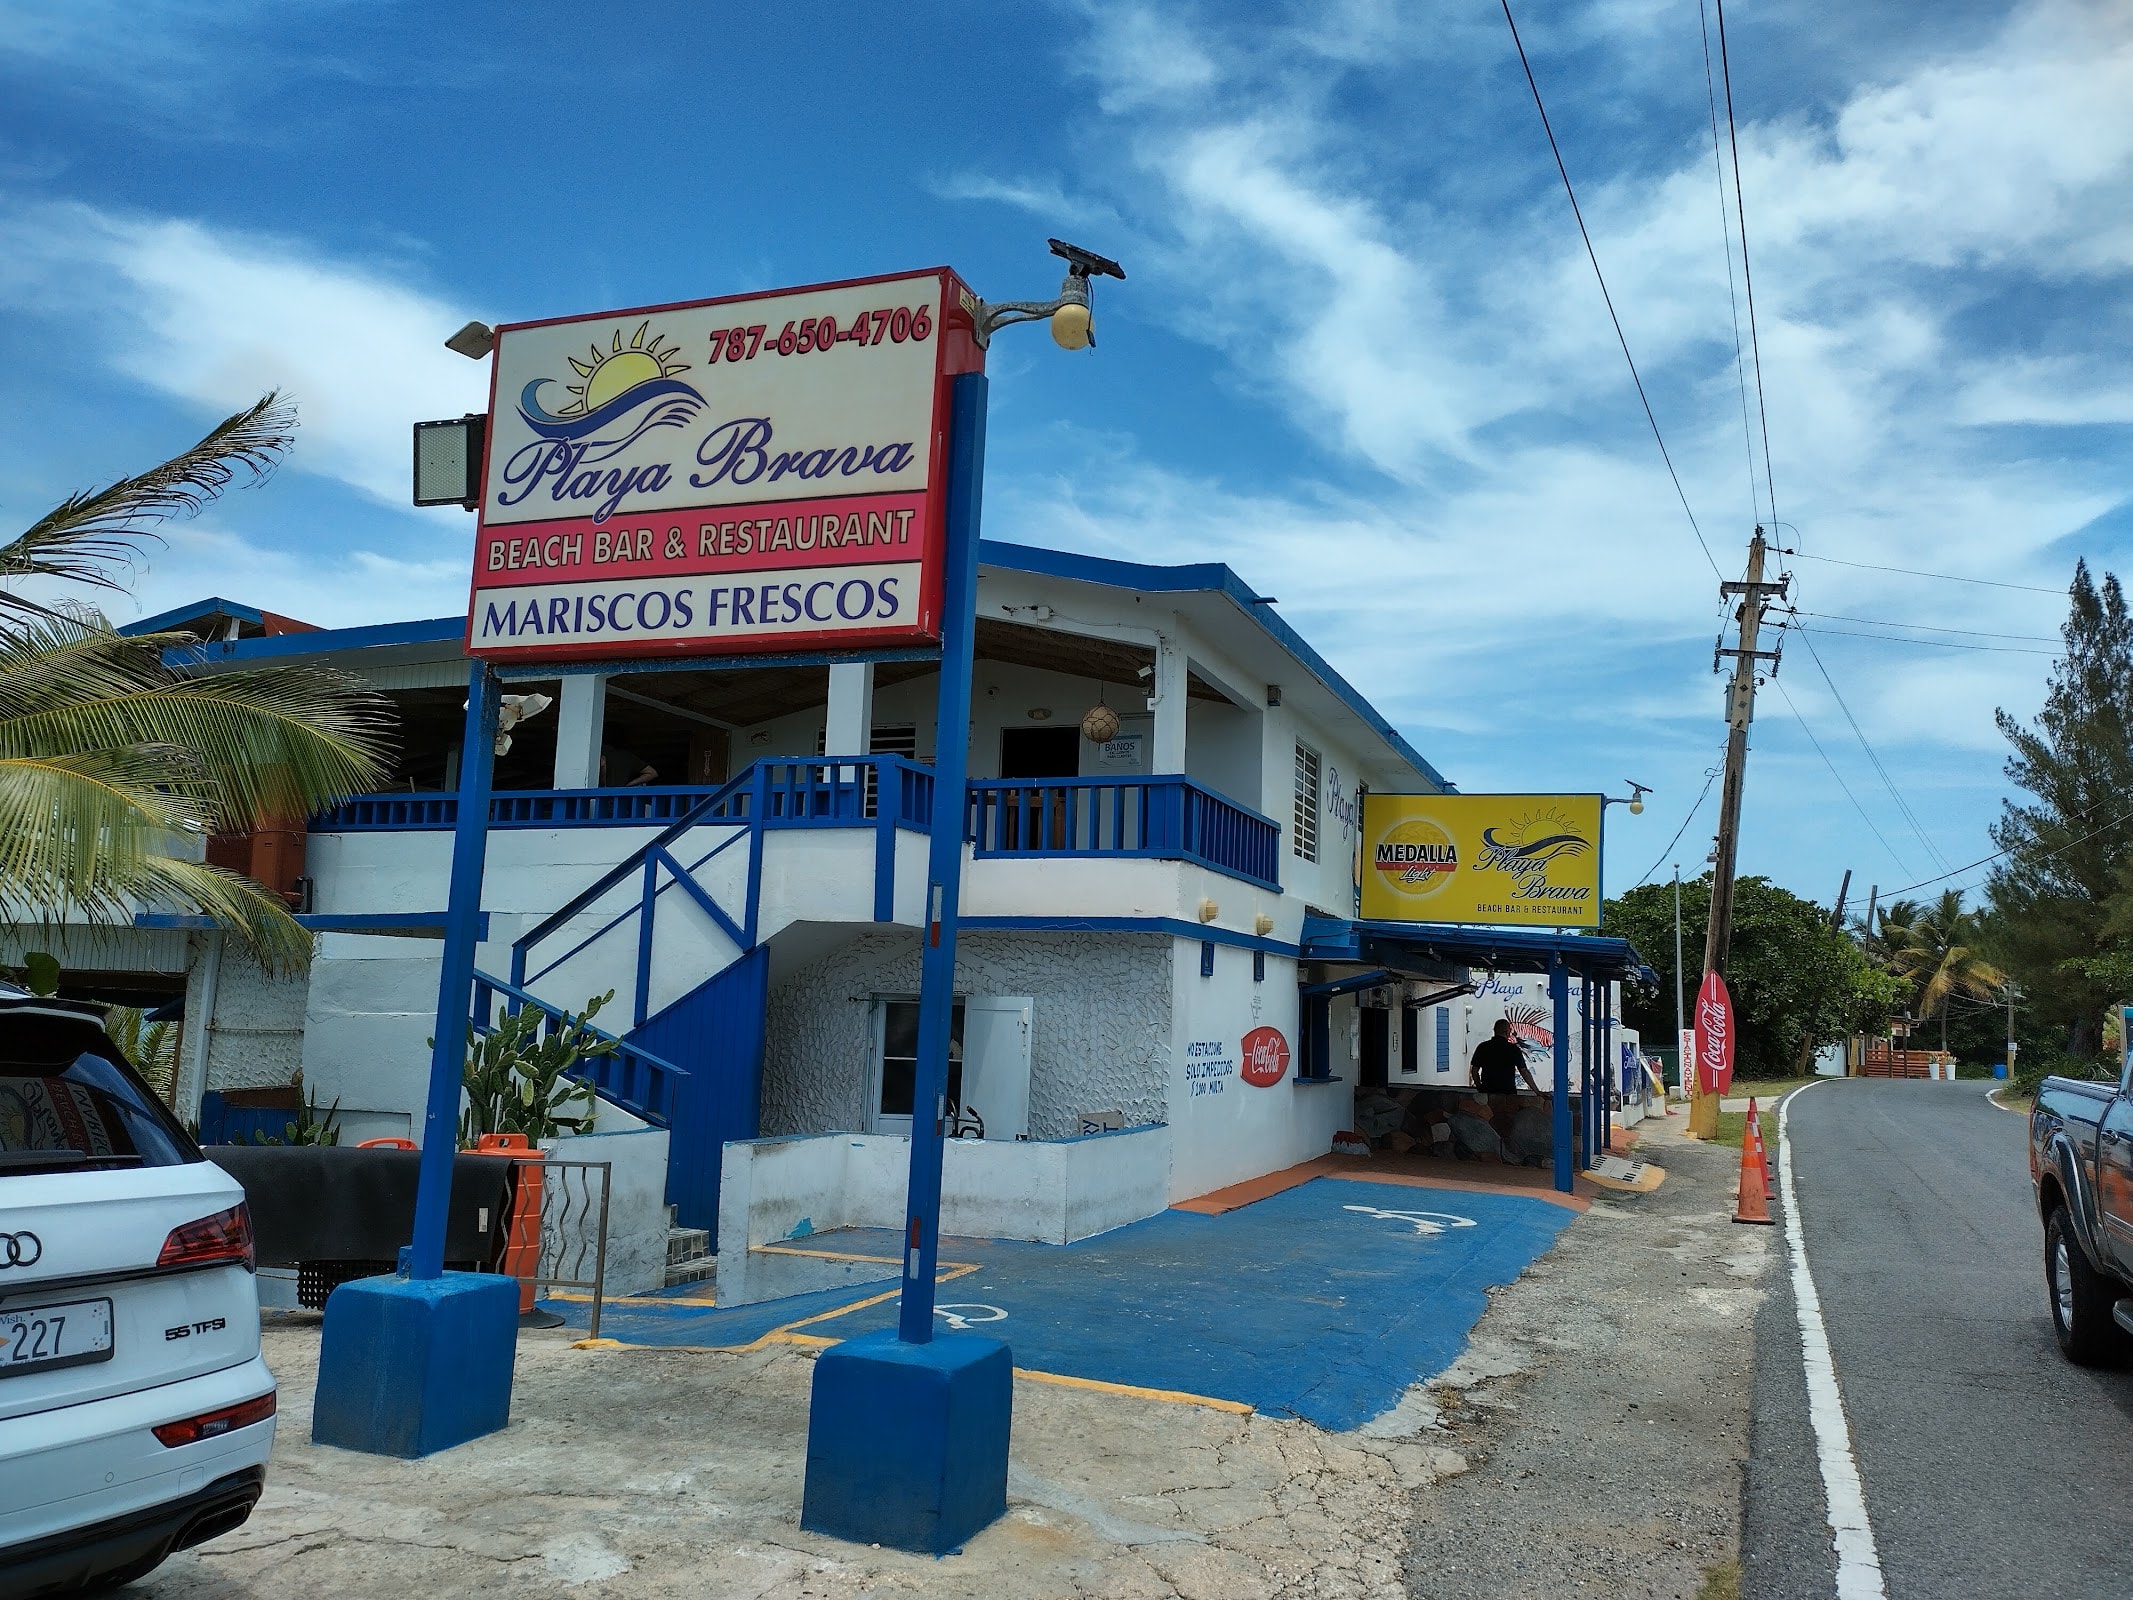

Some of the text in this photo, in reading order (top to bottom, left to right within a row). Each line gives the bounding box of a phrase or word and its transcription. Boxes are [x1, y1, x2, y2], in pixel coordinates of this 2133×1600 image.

[709, 305, 931, 363] 787-650-4706
[498, 417, 915, 525] Playa Brava
[488, 509, 916, 571] BEACH BAR & RESTAURANT
[482, 577, 900, 638] MARISCOS FRESCOS
[1327, 767, 1354, 841] Playa
[1376, 843, 1458, 863] MEDALLA
[1472, 846, 1548, 880] Playa
[1399, 865, 1436, 883] Light
[1511, 873, 1590, 900] Brava
[1477, 904, 1502, 912] BEACH
[1505, 904, 1520, 913] BAR
[1532, 905, 1583, 914] RESTAURANT
[1474, 980, 1523, 1001] Playa
[1186, 1063, 1200, 1080] SOLO
[12, 1316, 66, 1361] 227
[165, 1317, 226, 1341] 55 TFSI
